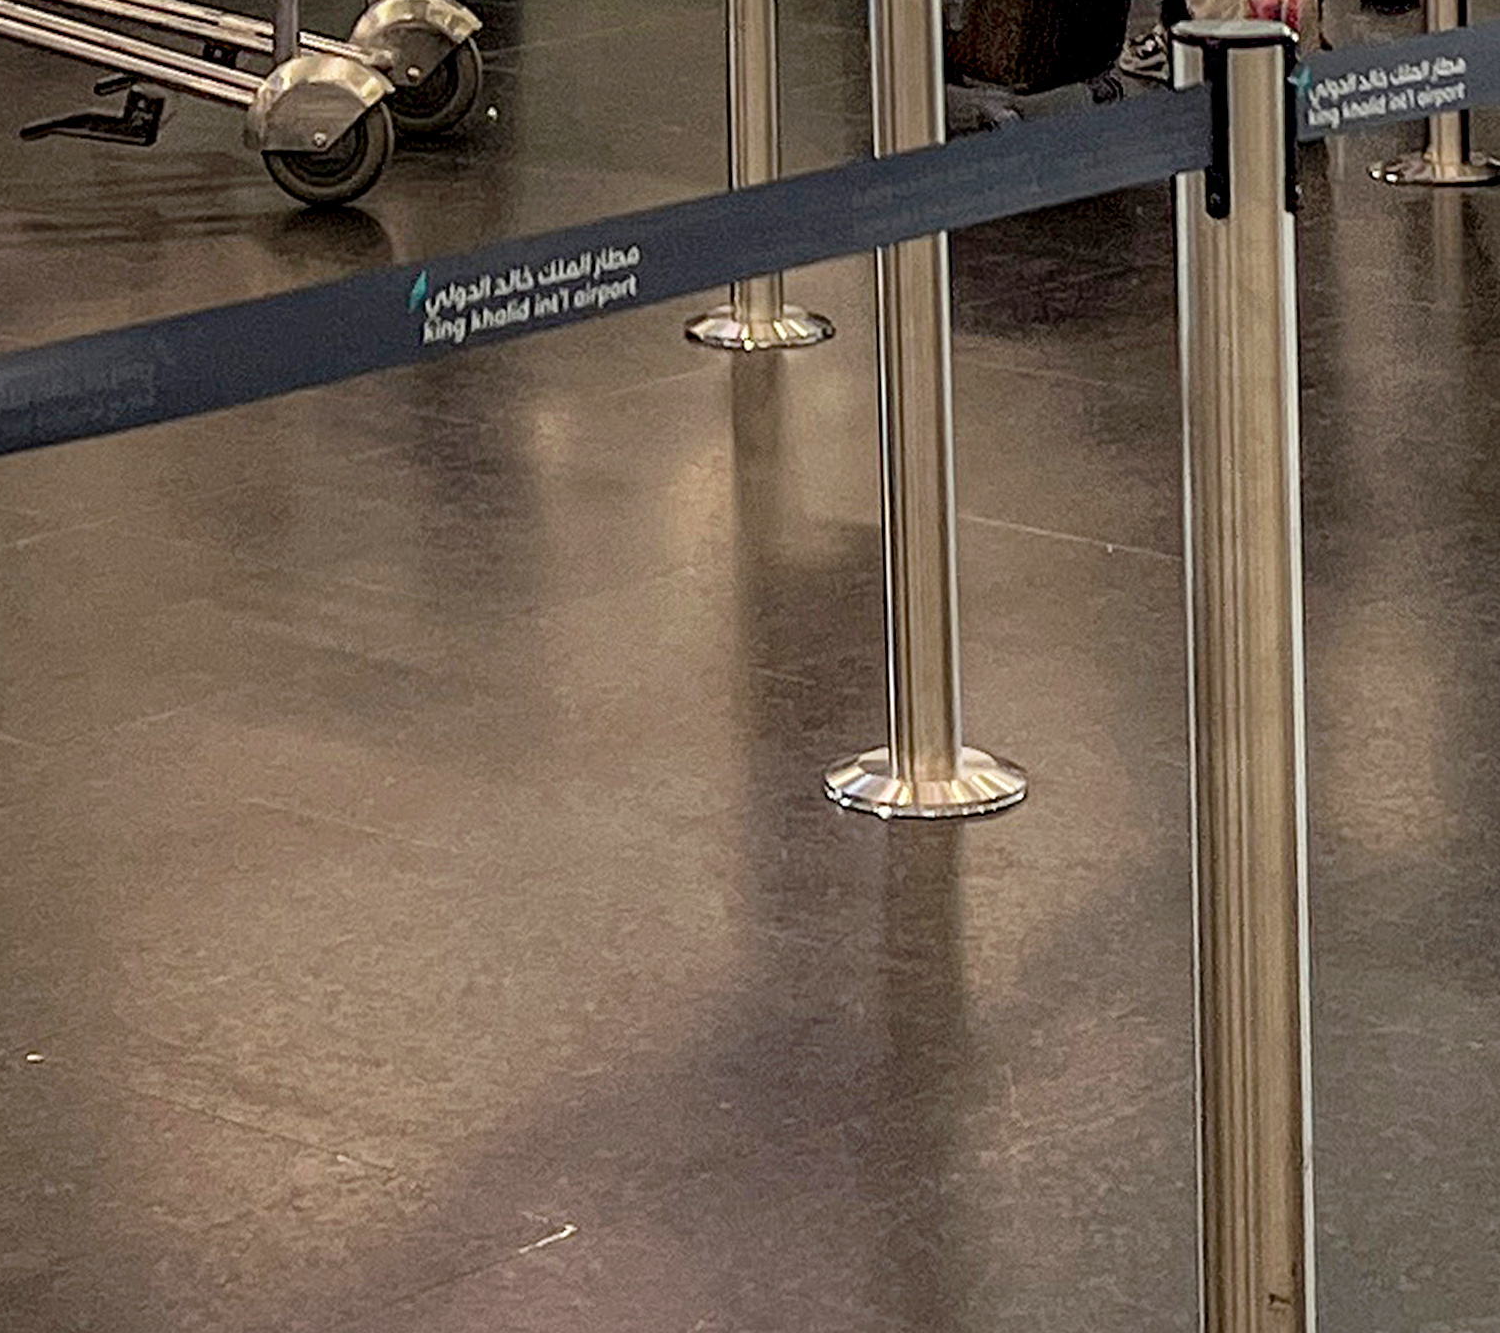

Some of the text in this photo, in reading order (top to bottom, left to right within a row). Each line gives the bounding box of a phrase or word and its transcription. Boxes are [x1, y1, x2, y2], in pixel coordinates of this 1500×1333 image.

[422, 274, 638, 345] king khalid int'l airport
[424, 245, 641, 324] مطار الملك خالد الدولي
